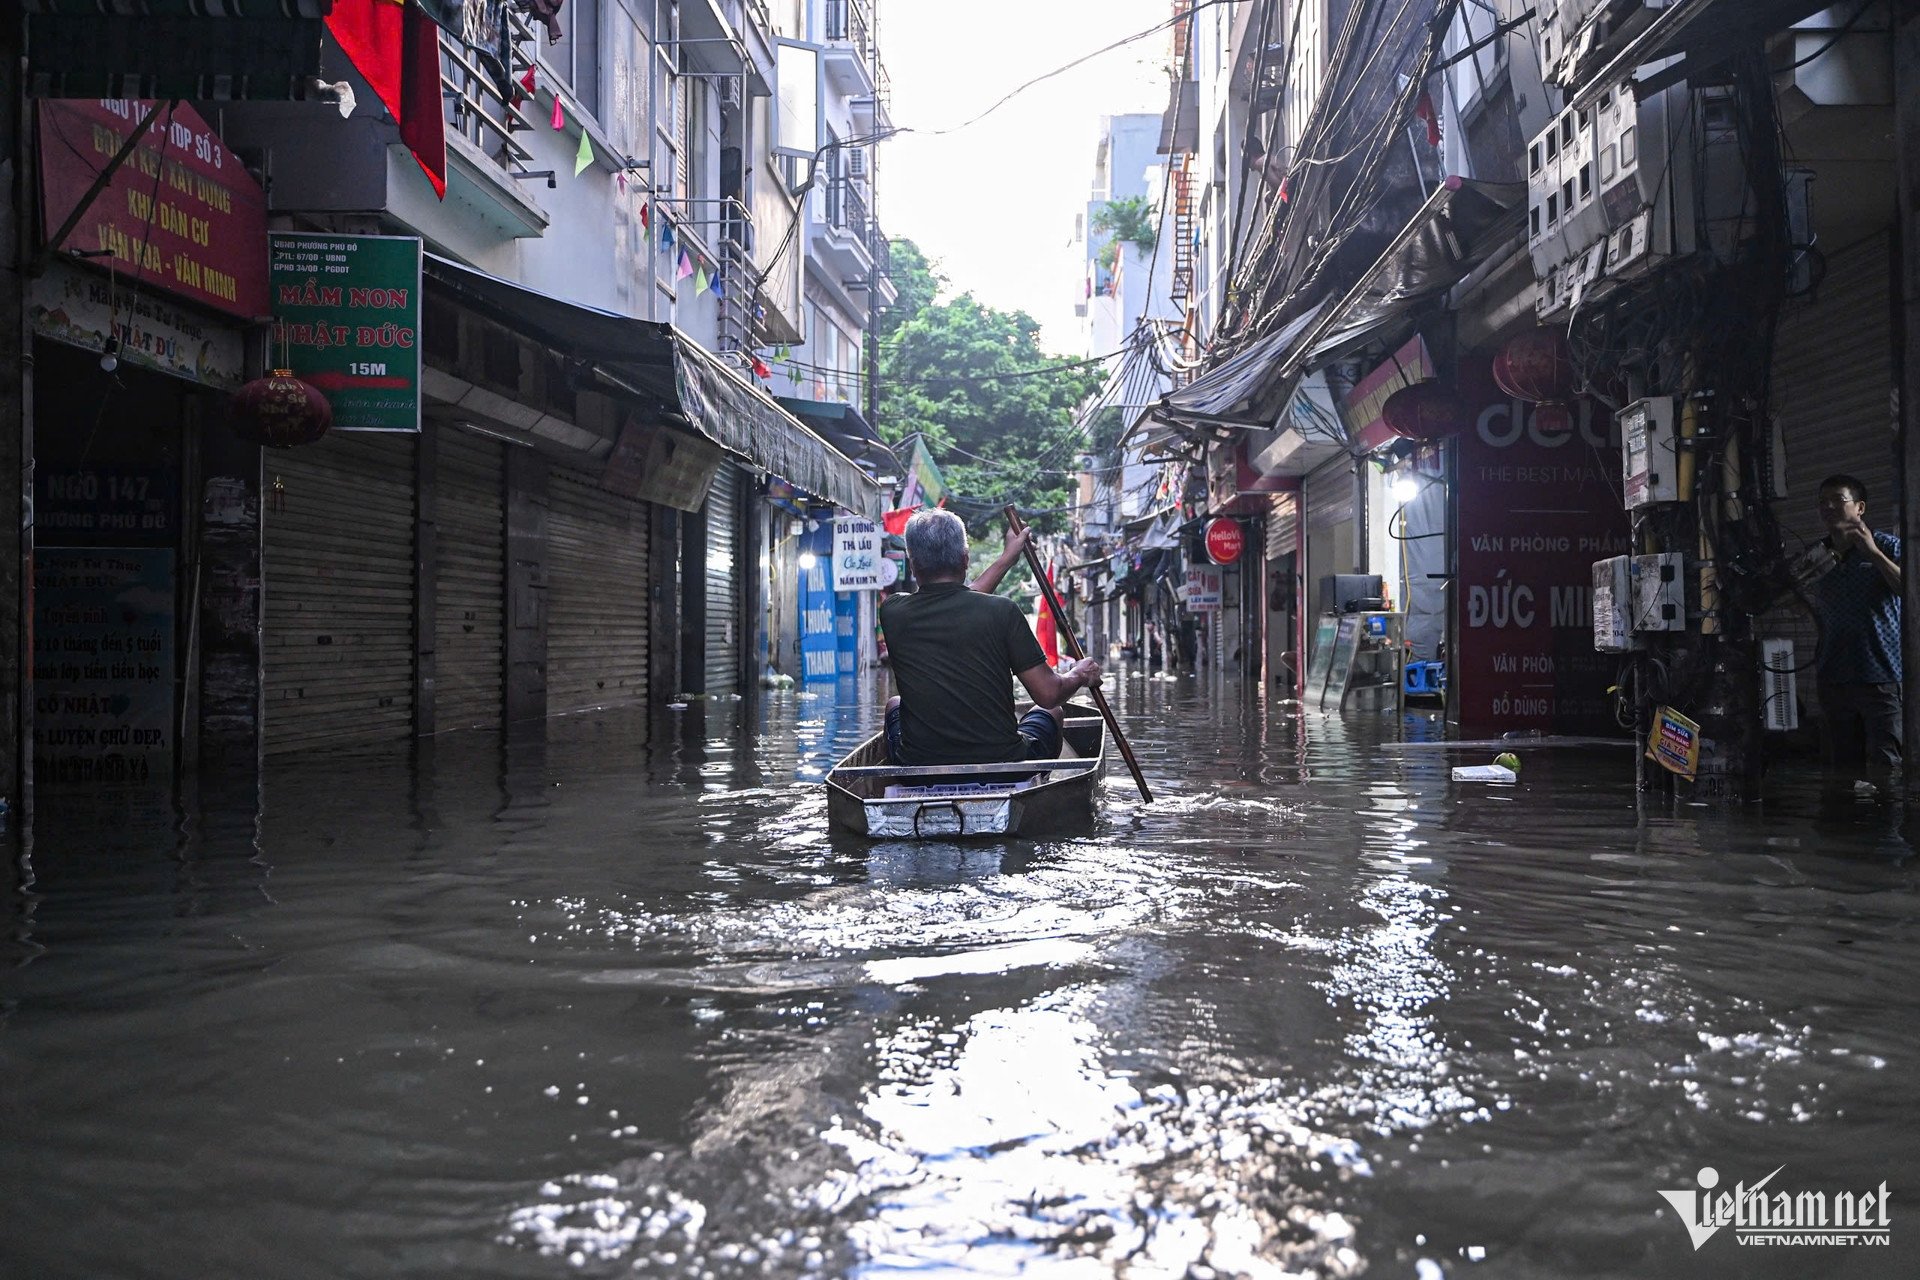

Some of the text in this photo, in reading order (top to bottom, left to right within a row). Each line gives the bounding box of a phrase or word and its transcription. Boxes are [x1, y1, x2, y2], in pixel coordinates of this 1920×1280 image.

[171, 121, 191, 151] TDP
[195, 132, 211, 163] SỐ
[214, 145, 221, 168] 3
[168, 160, 193, 196] XÂY
[128, 187, 209, 247] KHU DÂN CƯ
[98, 222, 129, 262] VĂN
[174, 251, 200, 288] VĂN
[204, 266, 236, 302] MINH
[349, 287, 408, 309] NON
[271, 320, 414, 350] NHẬT ĐỨC
[350, 362, 387, 376] 15M
[47, 471, 150, 501] NGÕ 147
[1478, 466, 1512, 481] THE
[1518, 466, 1557, 481] BEST
[1471, 532, 1504, 552] VĂN
[1510, 532, 1570, 552] PHÒNG
[1468, 568, 1535, 629] ĐỨC
[802, 601, 833, 634] THUỐC
[804, 650, 836, 676] THANH
[1492, 652, 1517, 673] VĂN
[64, 692, 111, 718] NHẬT
[1492, 690, 1511, 716] ĐỒ
[1514, 694, 1548, 716] DÙNG
[48, 725, 97, 749] LUYỆN
